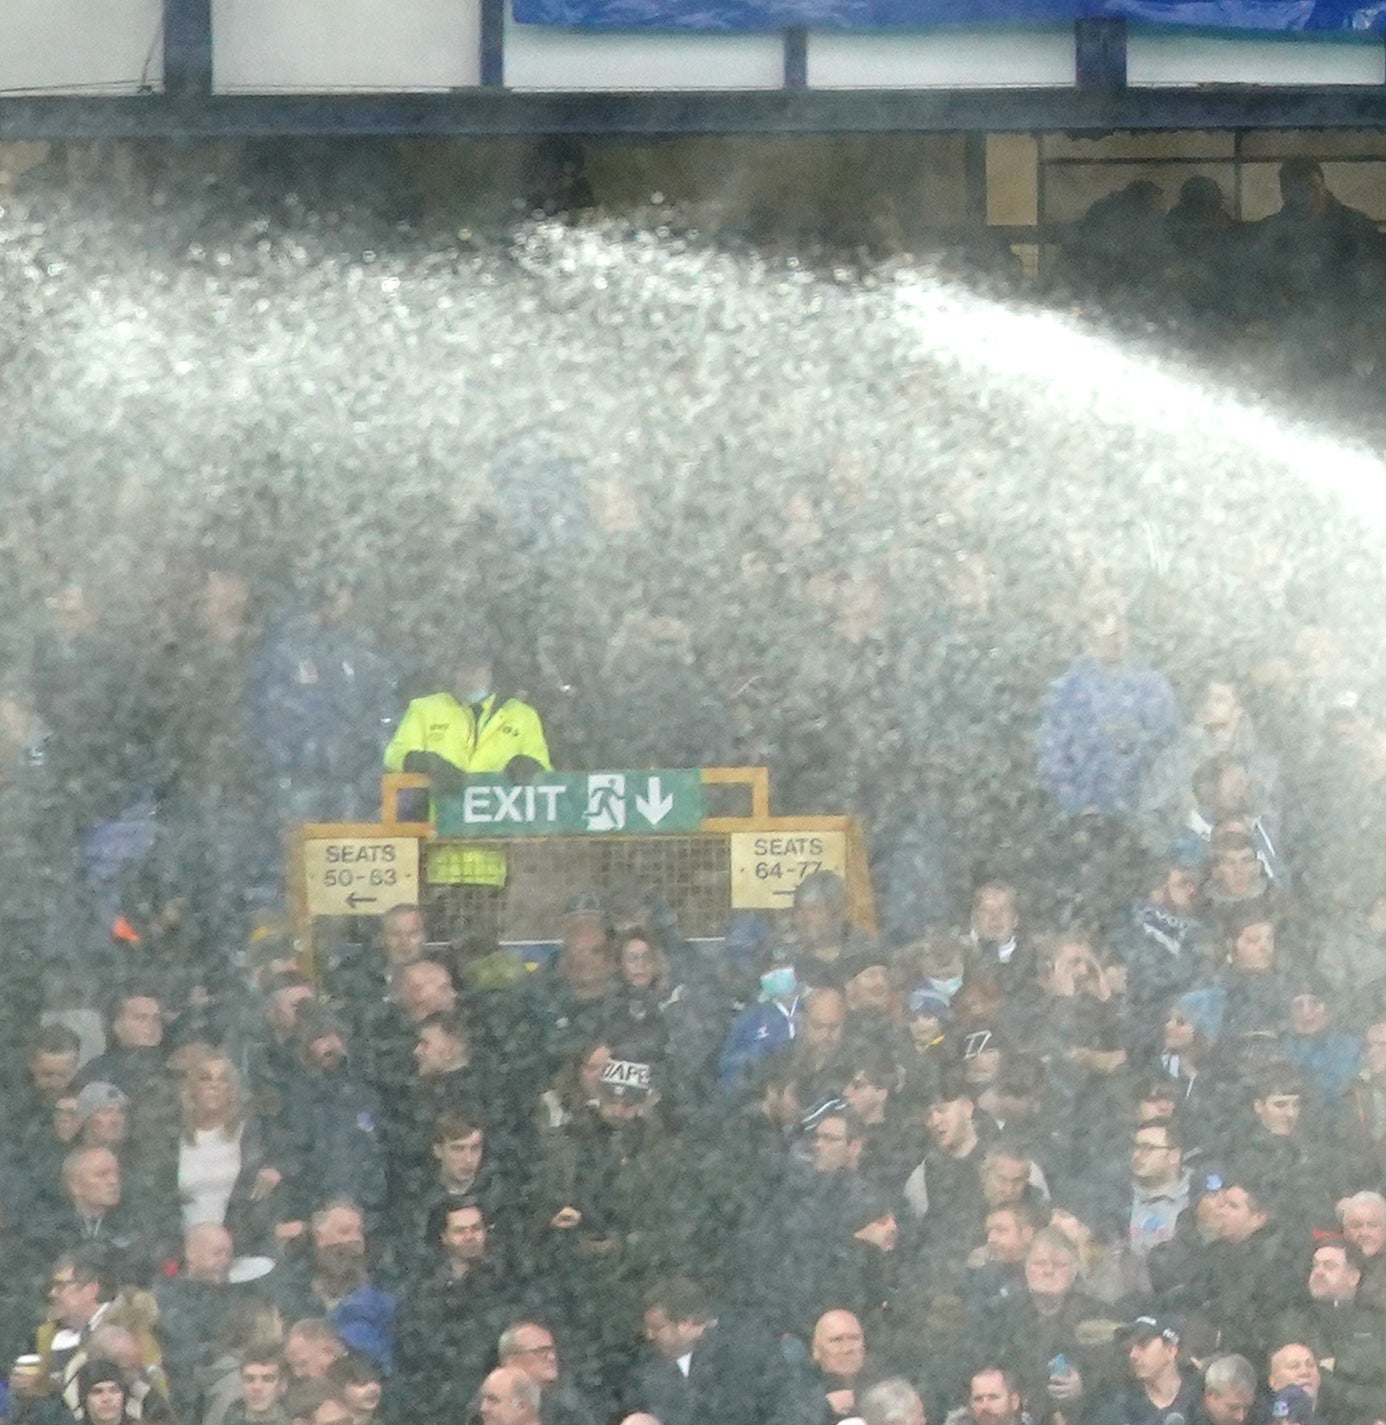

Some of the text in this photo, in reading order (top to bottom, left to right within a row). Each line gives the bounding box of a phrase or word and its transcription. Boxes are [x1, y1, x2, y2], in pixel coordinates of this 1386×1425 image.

[463, 784, 567, 823] EXIT
[325, 844, 397, 864] SEATS
[753, 837, 824, 857] SEATS
[754, 860, 823, 880] 64-77
